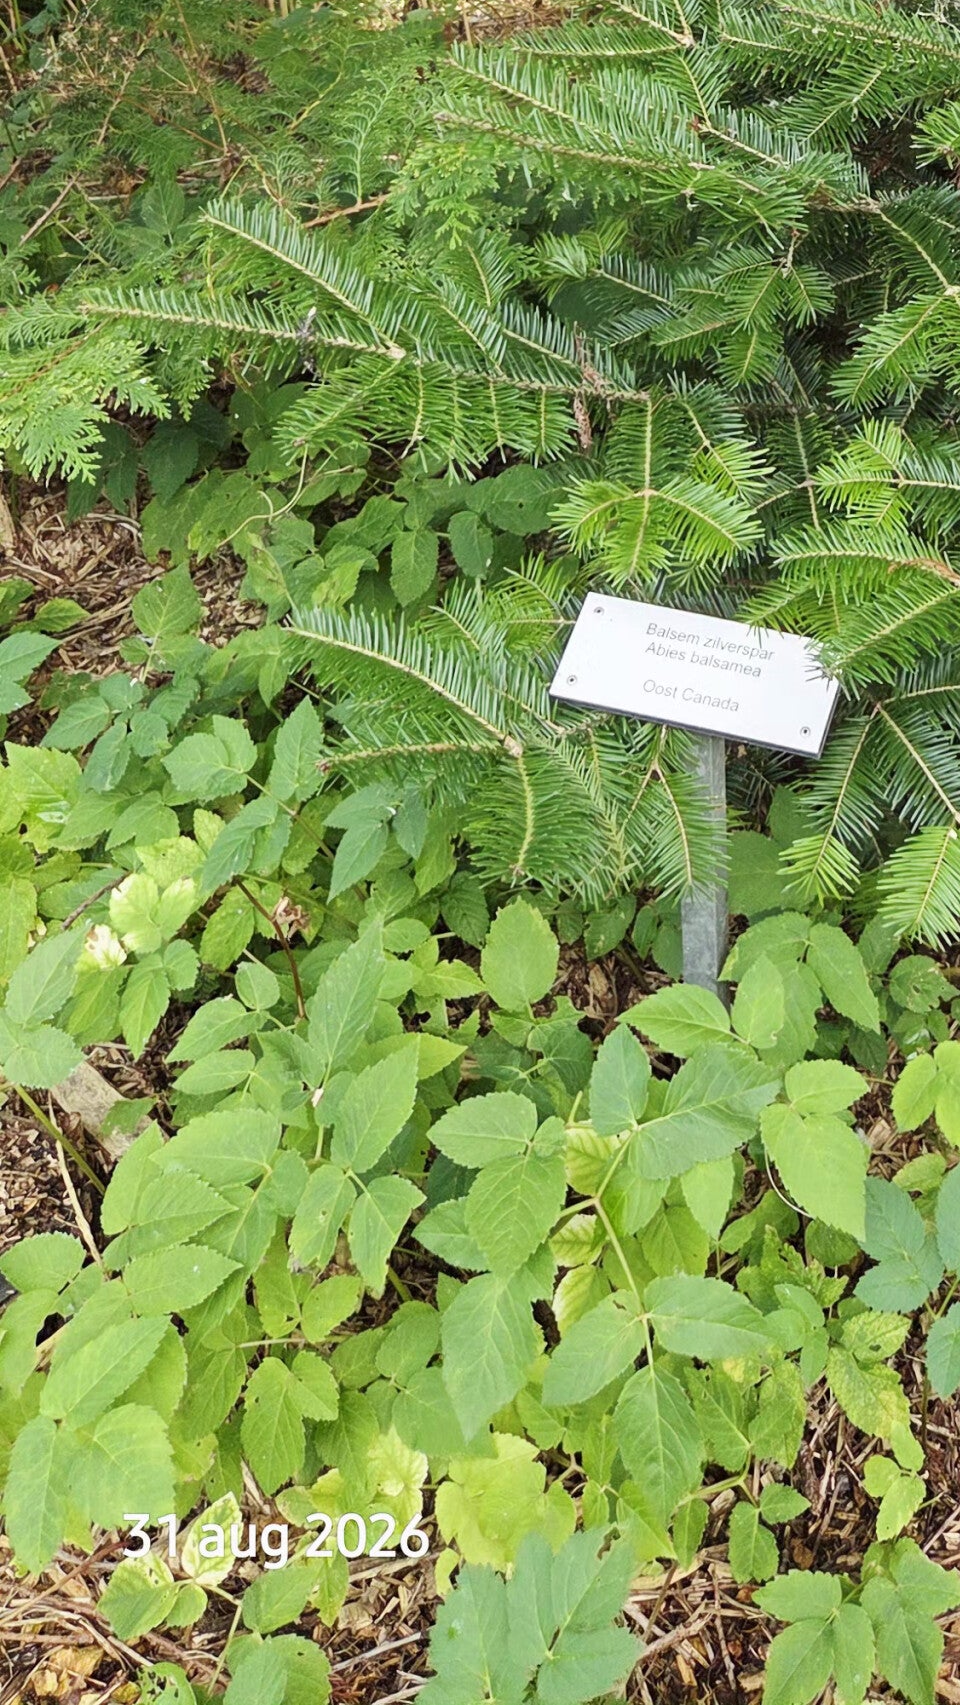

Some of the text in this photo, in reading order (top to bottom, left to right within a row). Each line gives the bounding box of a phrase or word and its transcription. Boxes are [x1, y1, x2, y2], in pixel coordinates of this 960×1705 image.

[646, 622, 776, 661] Balsem zilverspar
[645, 642, 762, 678] Abies balsamea
[643, 679, 740, 713] Oost Canada
